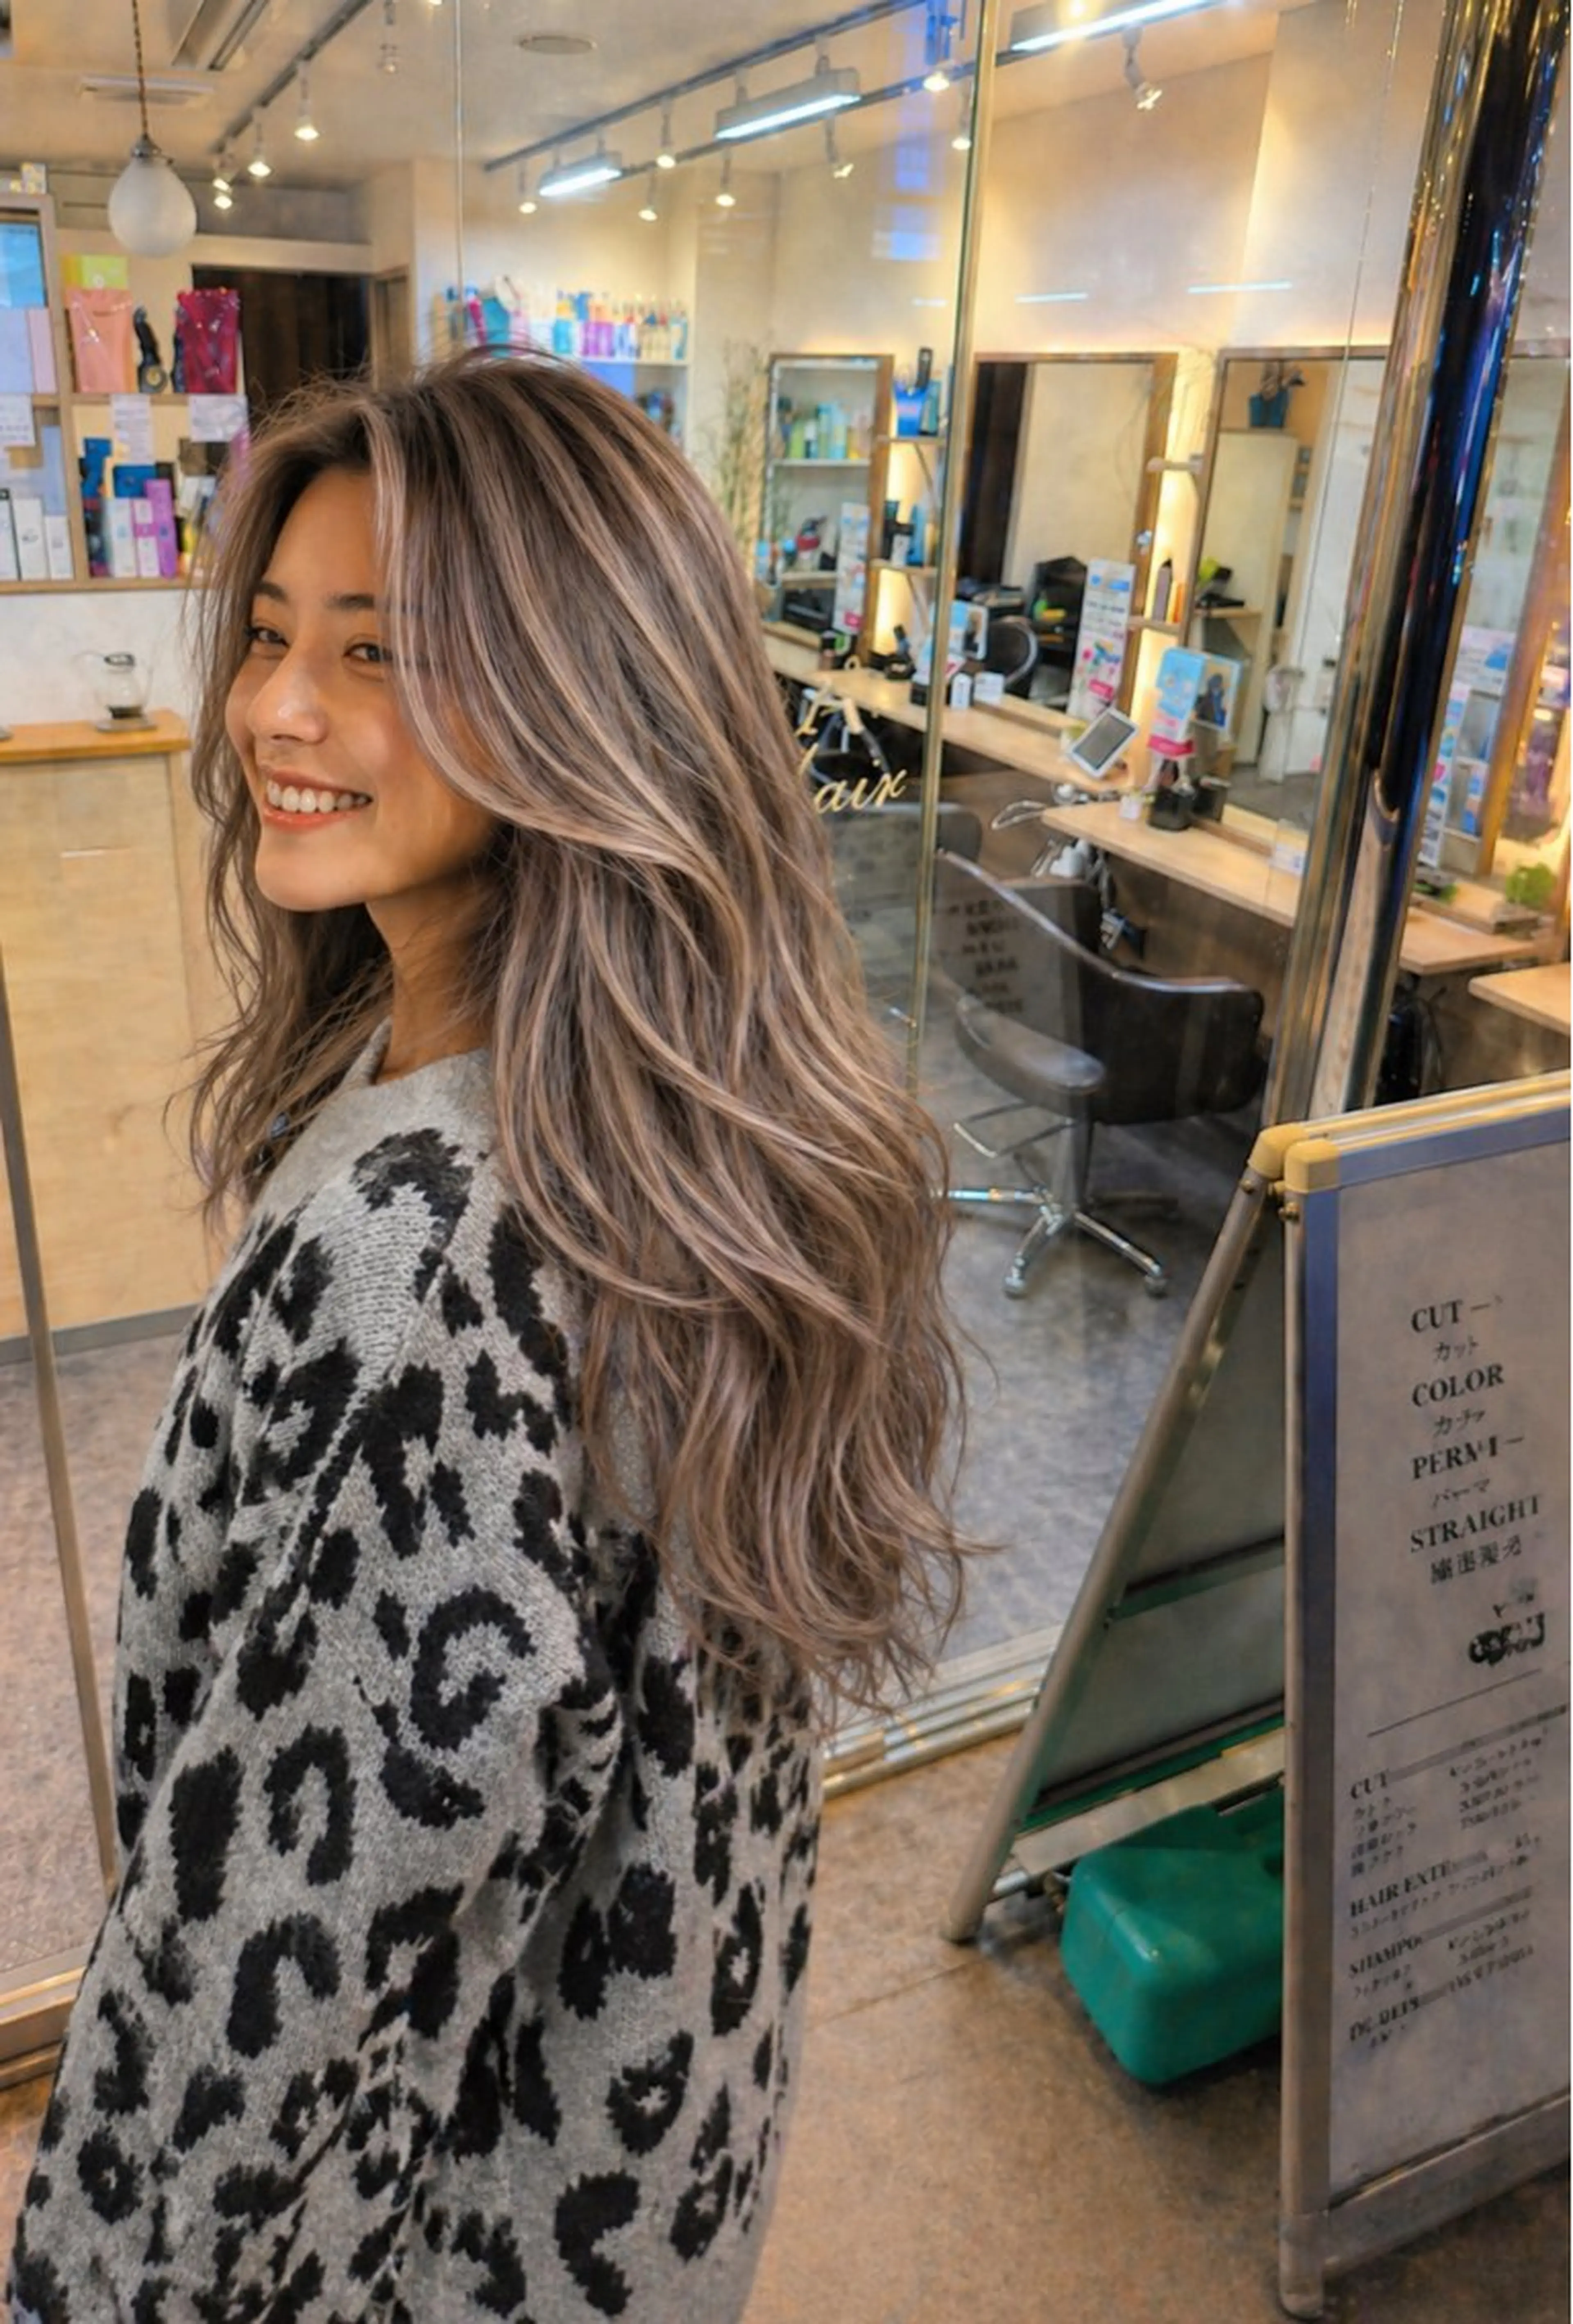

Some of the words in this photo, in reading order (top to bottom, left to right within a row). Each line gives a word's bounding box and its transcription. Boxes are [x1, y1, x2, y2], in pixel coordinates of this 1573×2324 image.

[1411, 1299, 1463, 1333] CUT
[1411, 1363, 1505, 1407] COLOR
[1410, 1494, 1542, 1553] STRAIGHT
